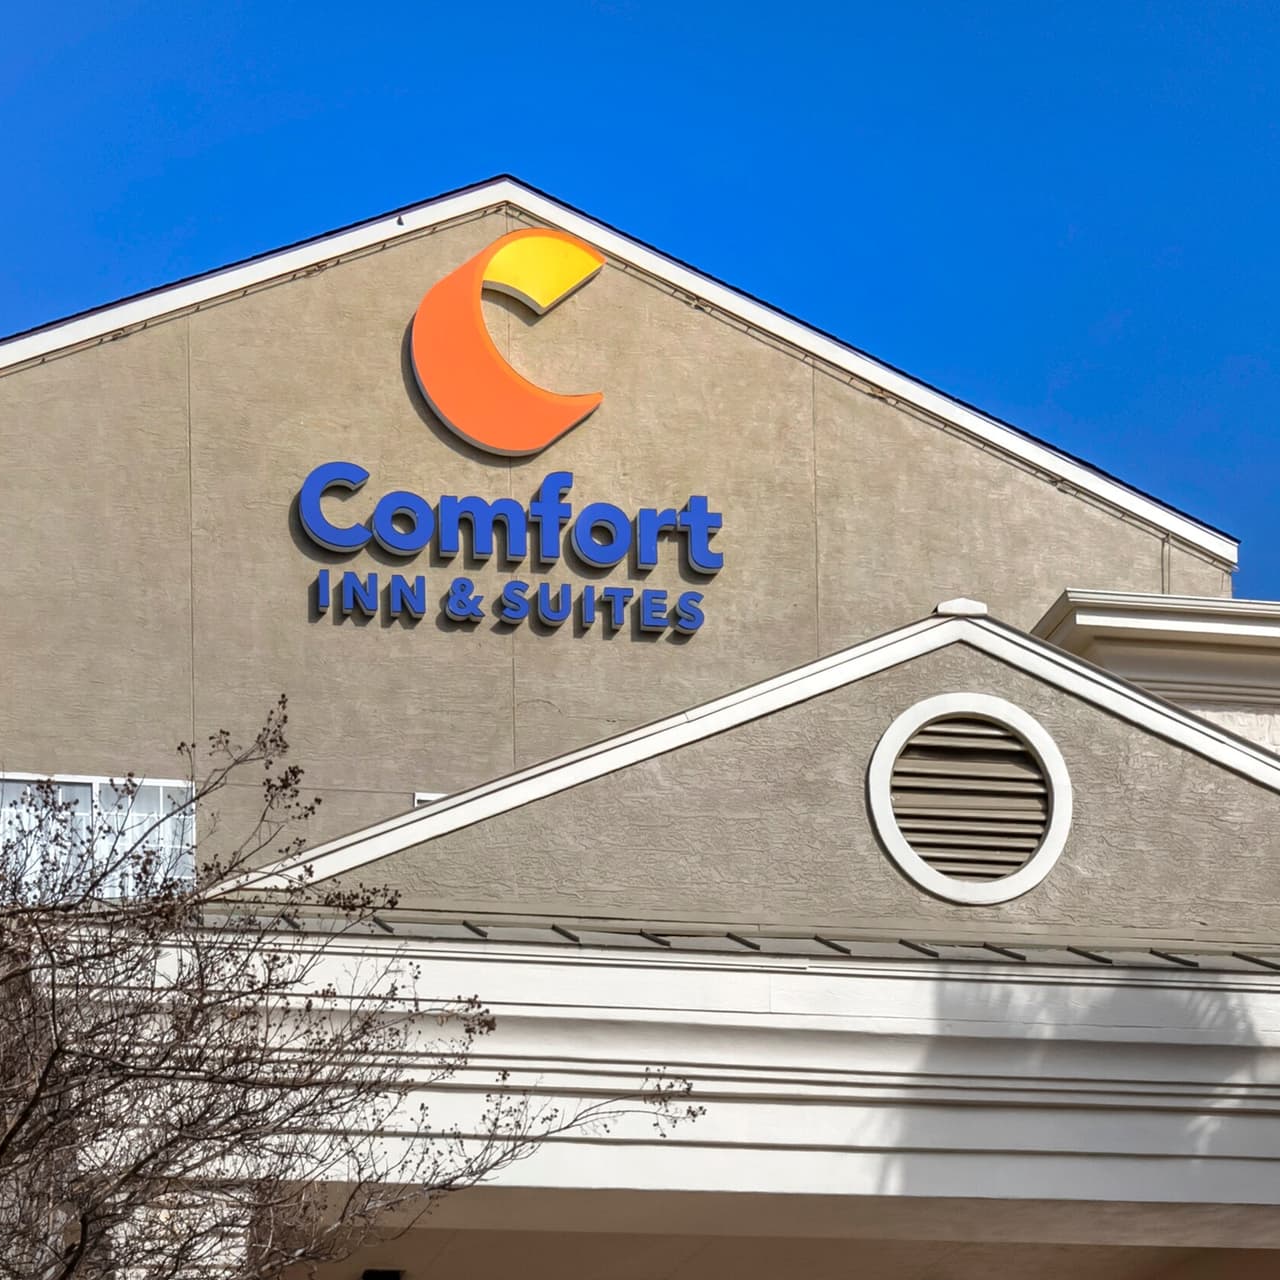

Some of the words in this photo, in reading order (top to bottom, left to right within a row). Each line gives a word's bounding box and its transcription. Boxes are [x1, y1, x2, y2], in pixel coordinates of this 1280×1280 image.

[298, 461, 724, 574] Comfort
[318, 569, 426, 619] INN
[445, 577, 485, 622] &
[500, 580, 705, 634] SUITES
